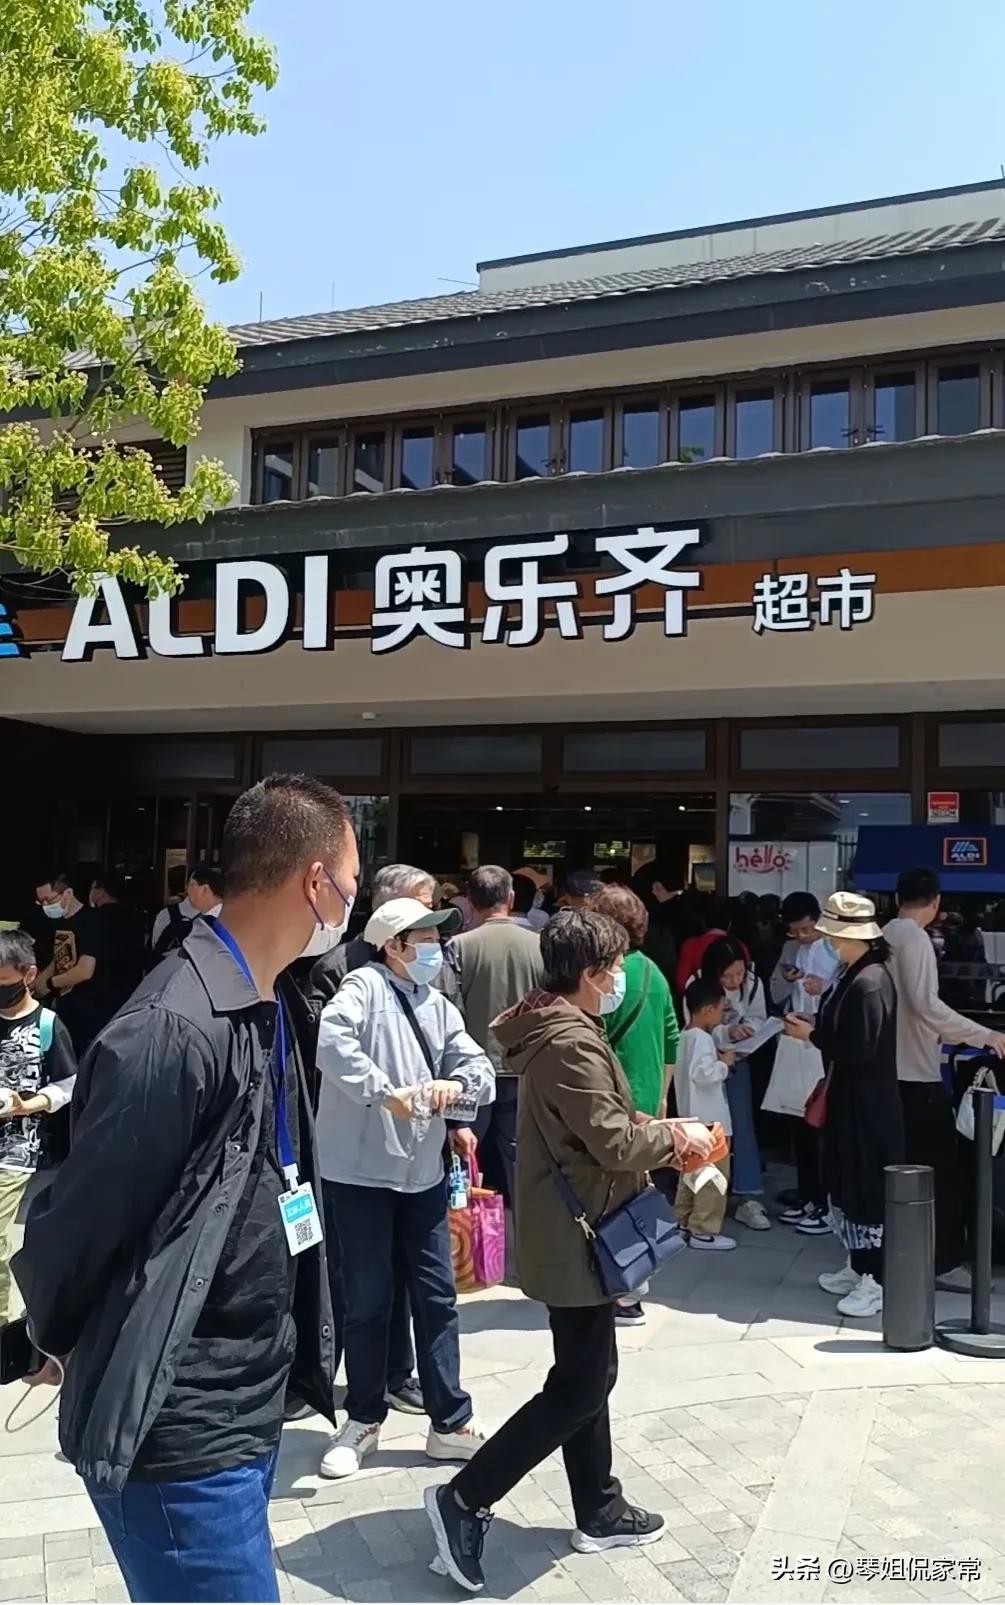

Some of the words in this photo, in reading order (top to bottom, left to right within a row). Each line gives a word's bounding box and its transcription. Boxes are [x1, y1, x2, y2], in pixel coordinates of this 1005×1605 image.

[62, 555, 329, 661] ALDI
[370, 526, 701, 653] 奥乐齐
[752, 567, 877, 634] 超市
[735, 844, 786, 868] hello
